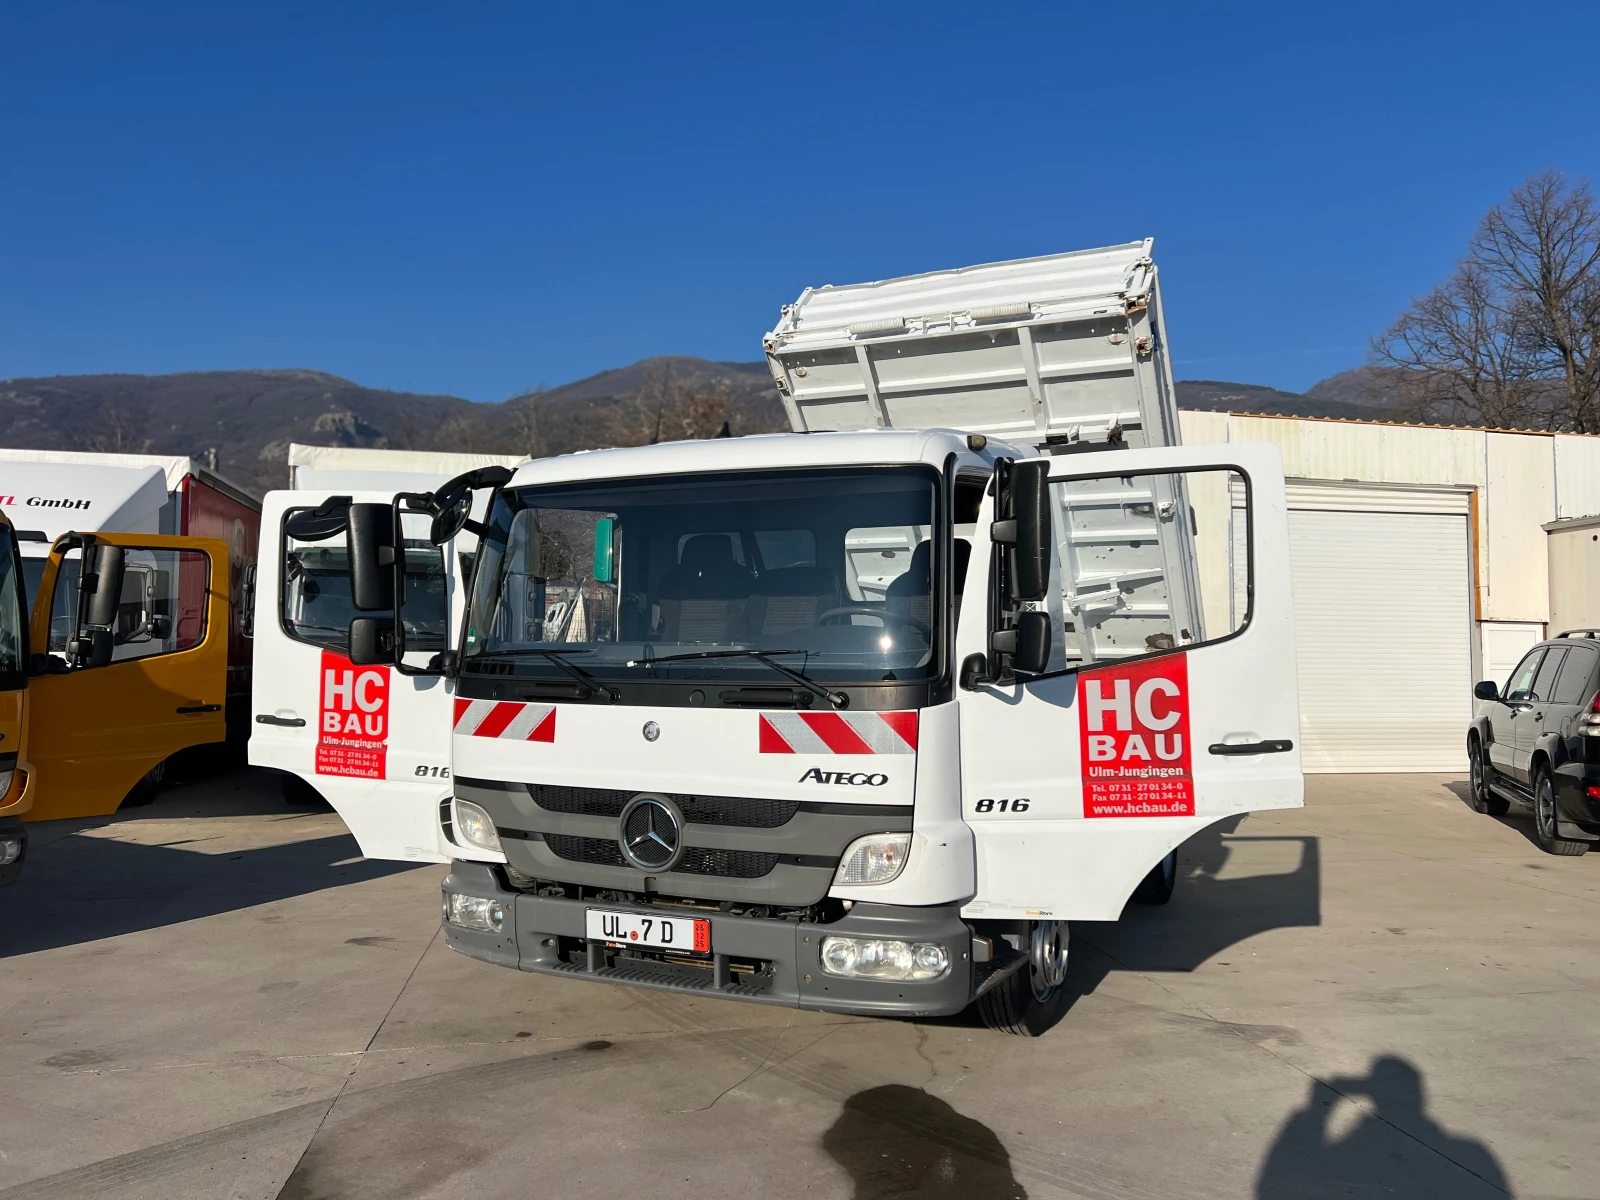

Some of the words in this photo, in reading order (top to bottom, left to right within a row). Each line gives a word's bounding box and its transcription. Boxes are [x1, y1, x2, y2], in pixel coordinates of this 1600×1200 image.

[26, 496, 91, 510] GmbH
[324, 669, 385, 713] HC
[1085, 677, 1181, 731] HC
[323, 711, 383, 736] BAU
[323, 735, 382, 748] Ulm-Jungingen
[1088, 734, 1183, 761] BAU
[319, 765, 379, 777] www.hcbau.de
[414, 765, 450, 778] 816
[798, 766, 889, 786] ATEGO
[1089, 765, 1184, 778] Ulm-Jungingen
[1092, 784, 1107, 792] Tel.
[974, 798, 1031, 813] 816
[1093, 801, 1187, 814] www.hcbau.de
[602, 914, 627, 939] UL
[641, 918, 653, 942] 7
[660, 920, 673, 944] D
[696, 932, 704, 940] 12
[695, 940, 705, 948] 25
